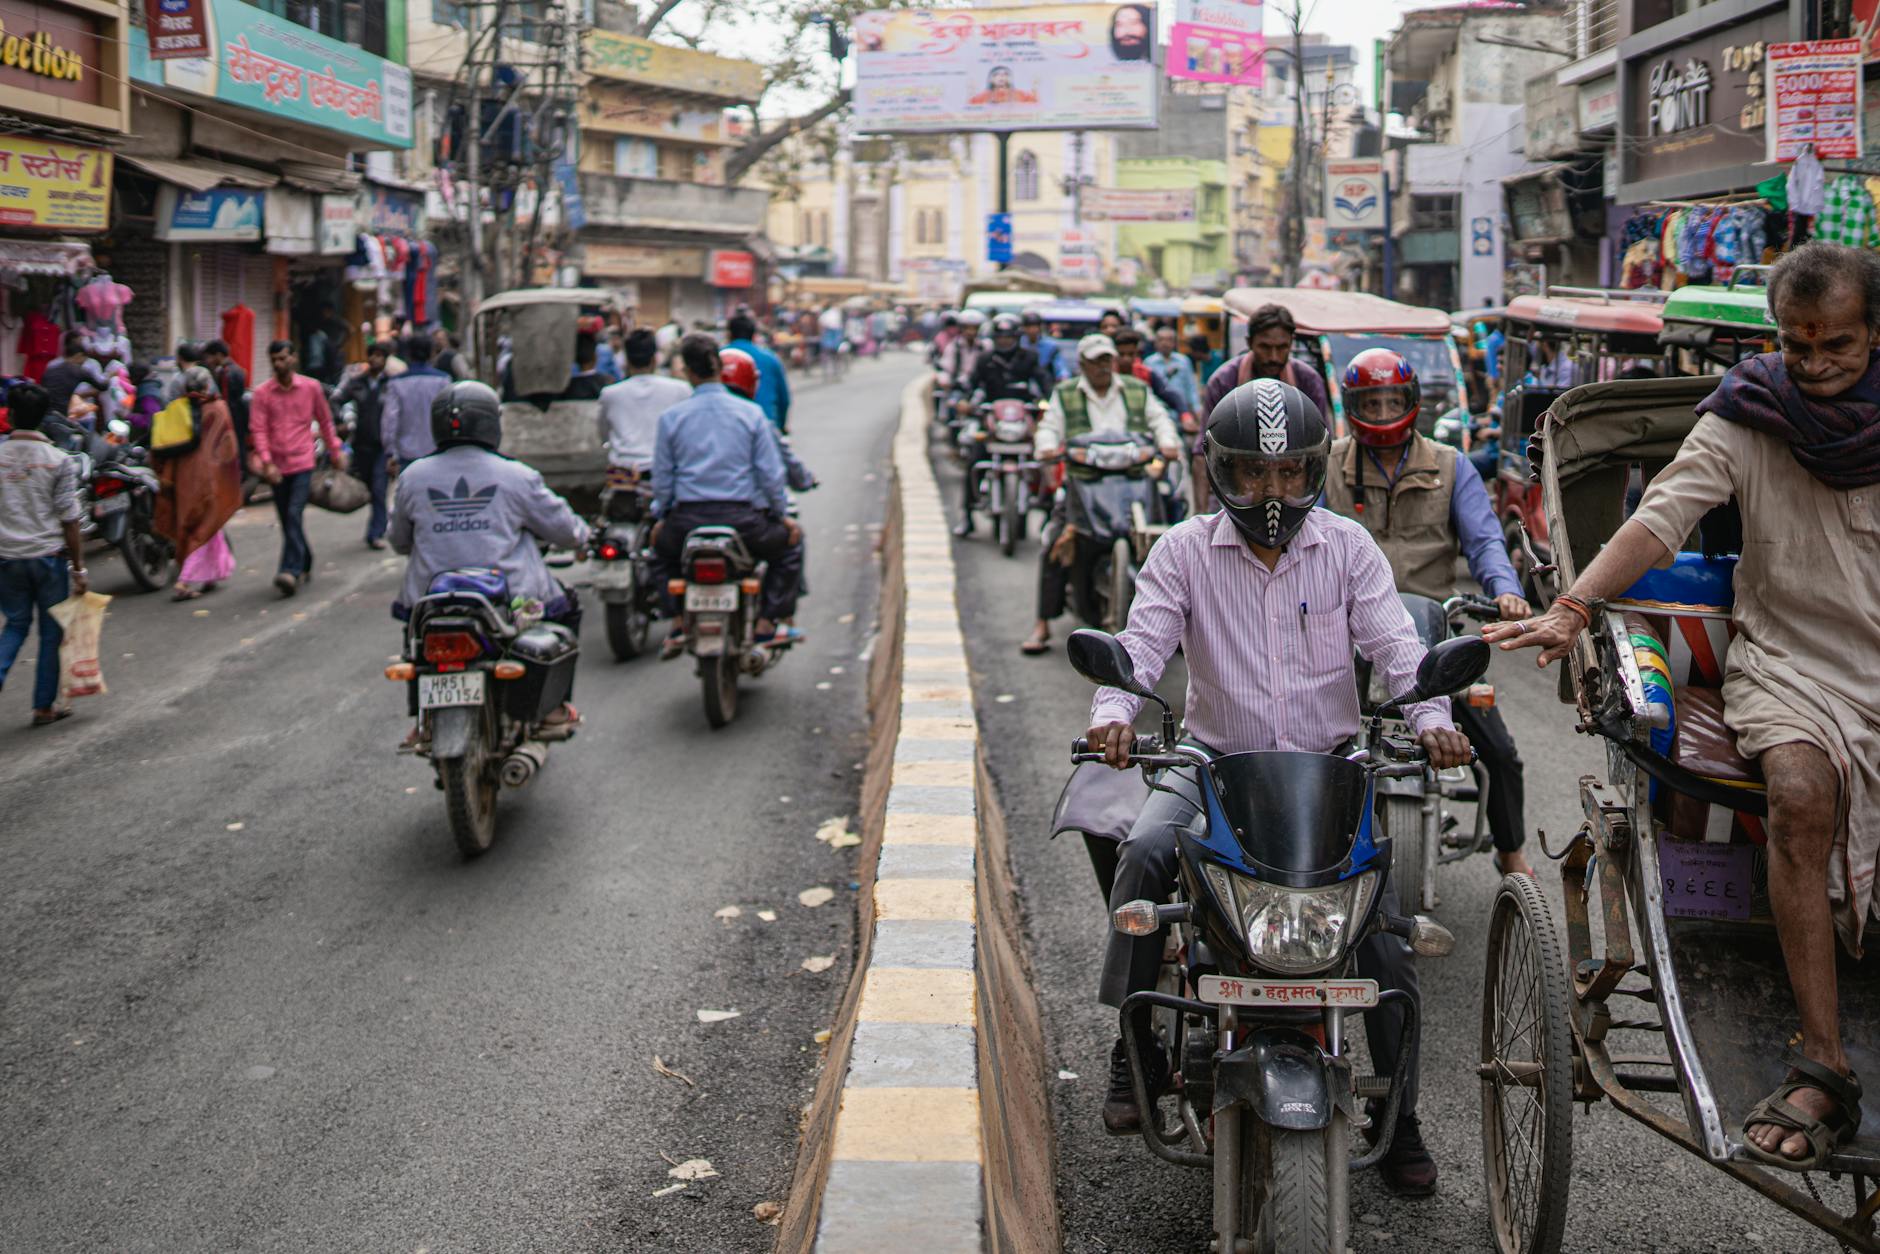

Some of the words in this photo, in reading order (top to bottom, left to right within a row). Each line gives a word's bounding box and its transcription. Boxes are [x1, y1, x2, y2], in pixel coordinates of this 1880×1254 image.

[1721, 40, 1765, 72] Toys
[1648, 84, 1711, 138] POINT
[1343, 183, 1368, 197] HP
[432, 517, 490, 535] adidas
[1218, 980, 1244, 999] श्री
